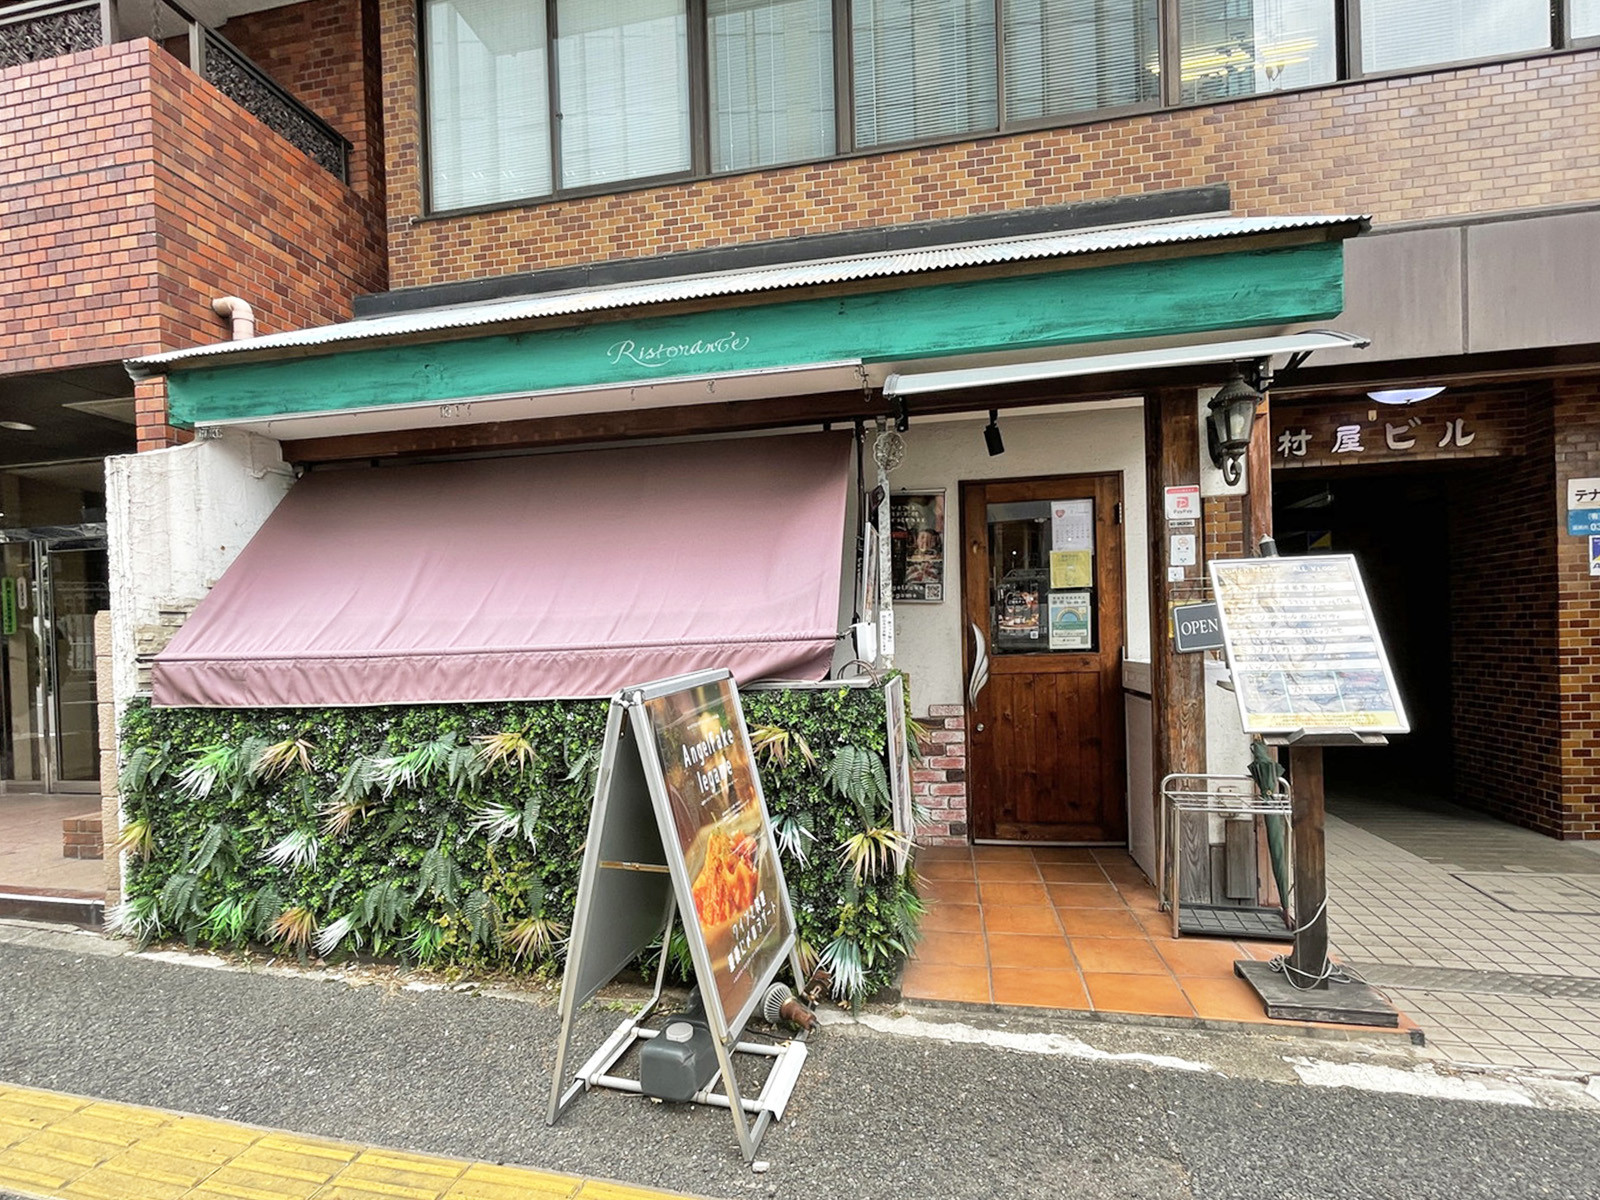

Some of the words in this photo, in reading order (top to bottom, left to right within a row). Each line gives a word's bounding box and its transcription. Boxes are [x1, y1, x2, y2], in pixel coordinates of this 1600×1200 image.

[606, 331, 750, 368] Ristorante
[1277, 416, 1476, 458] 村屋ビル
[1181, 618, 1218, 636] OPEN
